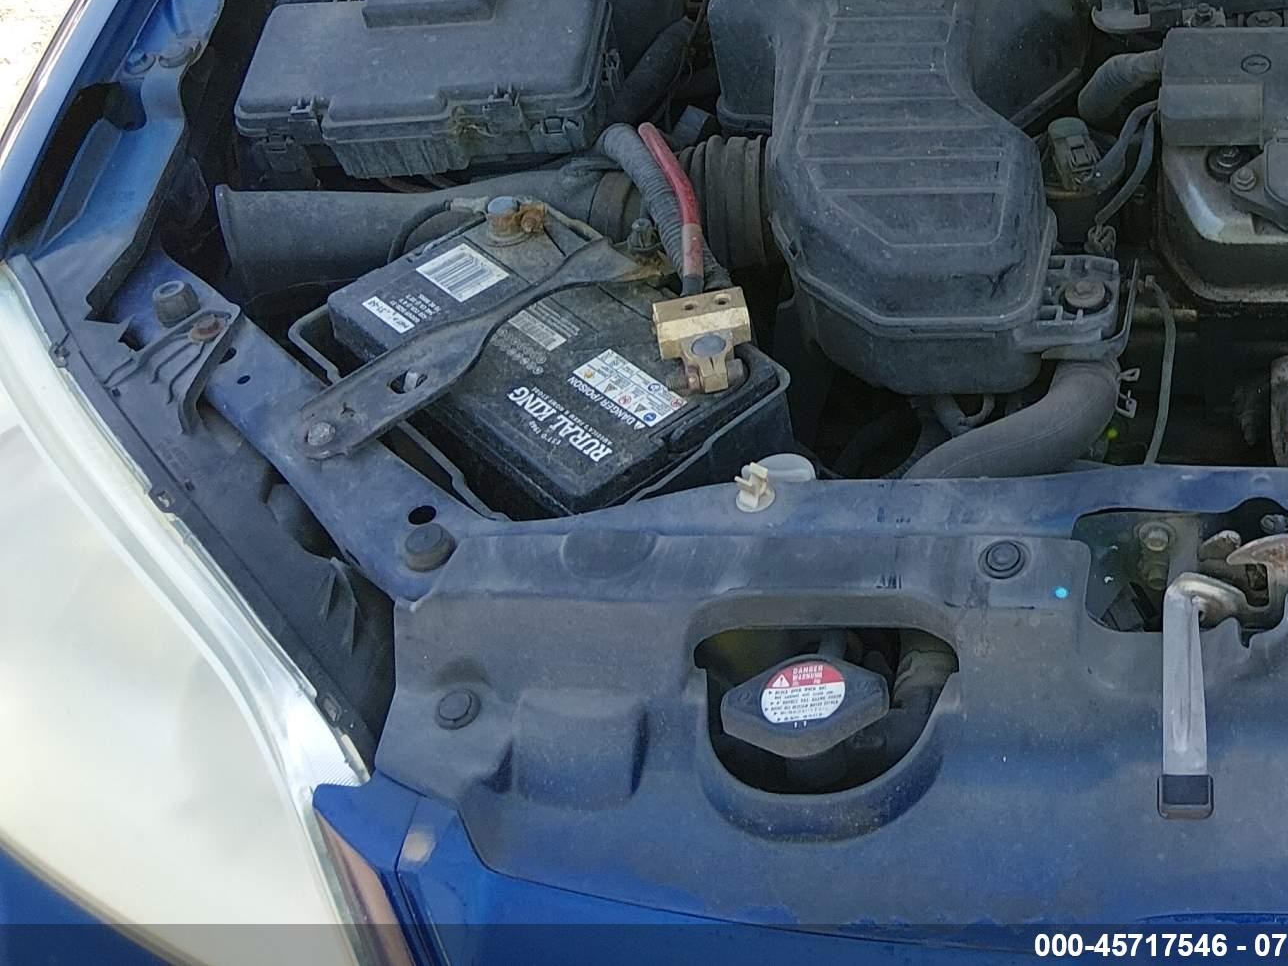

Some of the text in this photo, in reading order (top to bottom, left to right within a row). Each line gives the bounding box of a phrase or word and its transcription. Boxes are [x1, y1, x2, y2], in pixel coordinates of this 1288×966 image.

[507, 386, 557, 422] KING
[549, 414, 613, 462] RURAL
[792, 664, 823, 674] DANGER
